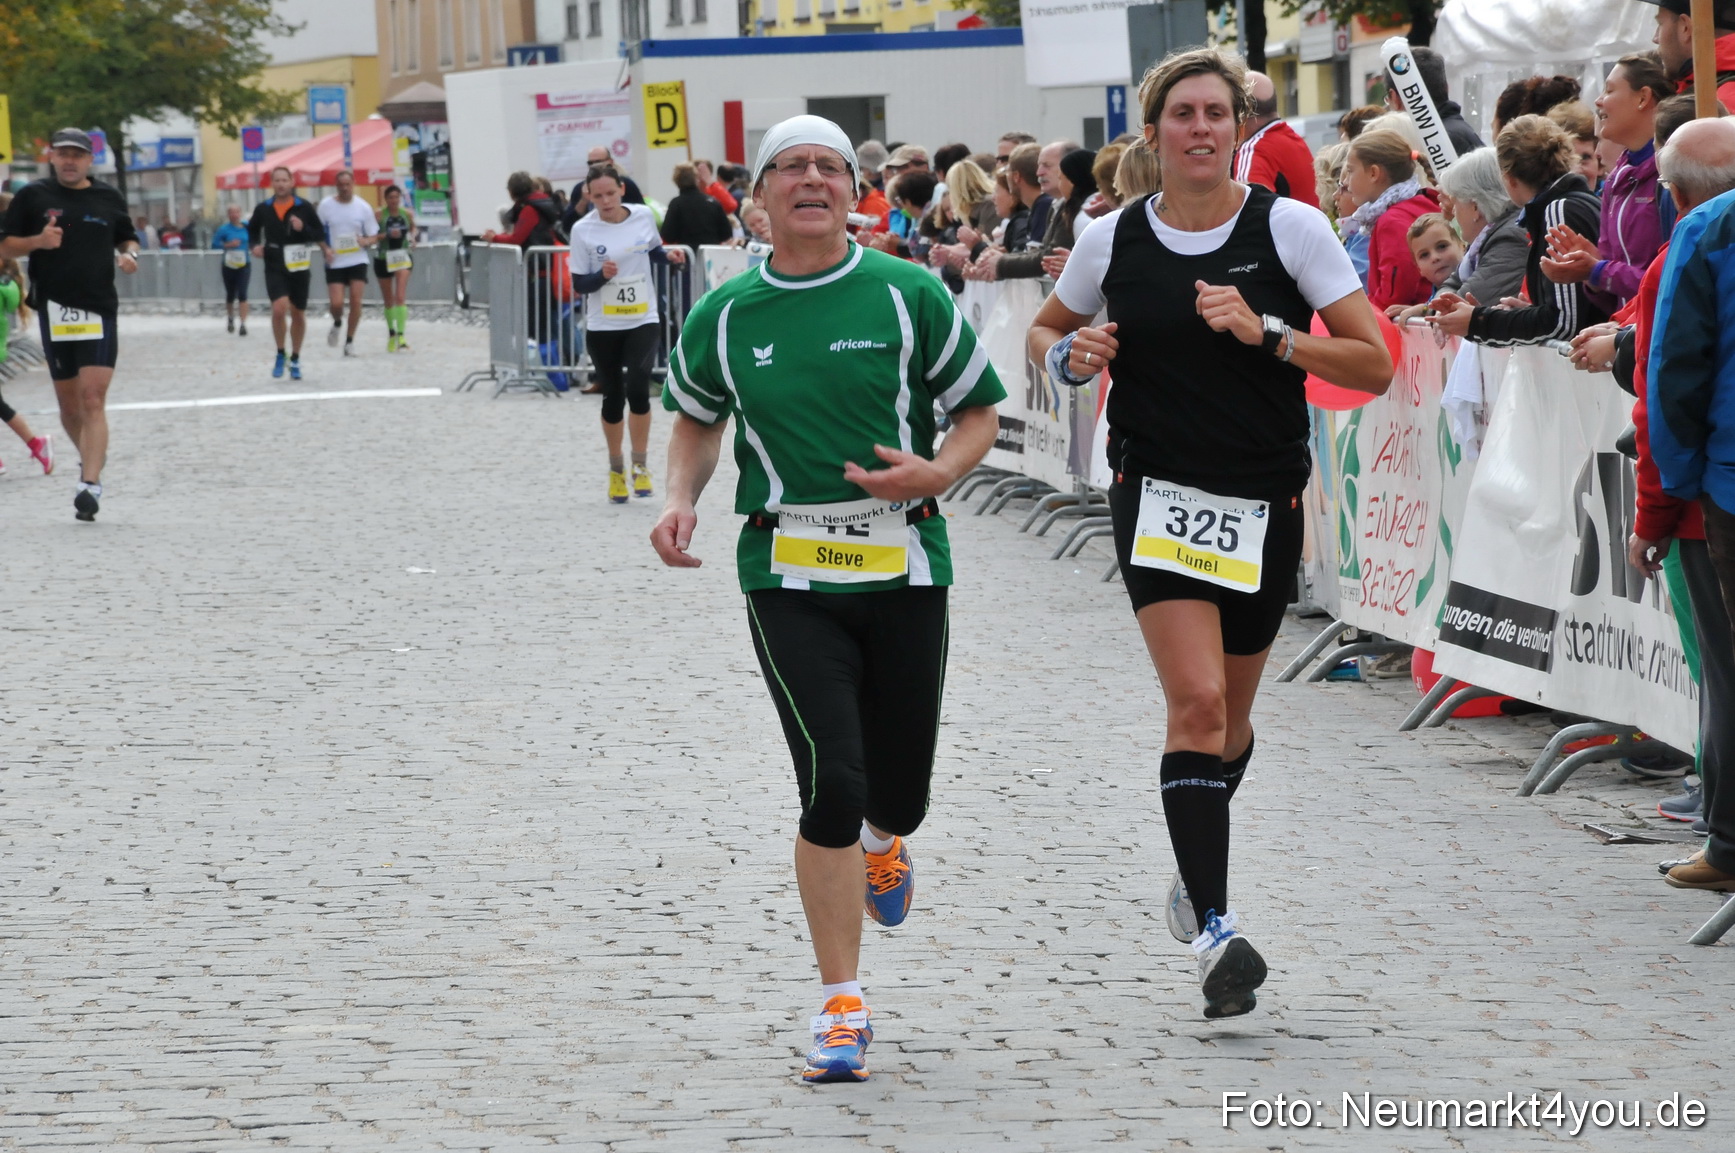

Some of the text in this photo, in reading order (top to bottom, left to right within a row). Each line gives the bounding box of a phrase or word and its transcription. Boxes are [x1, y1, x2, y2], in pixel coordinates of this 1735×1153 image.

[647, 85, 682, 98] Block
[1402, 83, 1436, 130] BMW
[655, 102, 678, 134] D
[616, 287, 636, 303] 43
[829, 339, 872, 352] africon
[755, 358, 773, 368] erima
[1145, 487, 1187, 502] PARTL
[823, 506, 885, 525] Neumarkt
[1165, 505, 1242, 553] 325
[816, 546, 864, 567] Steve
[1176, 547, 1219, 573] Lunel
[1493, 618, 1517, 643] die
